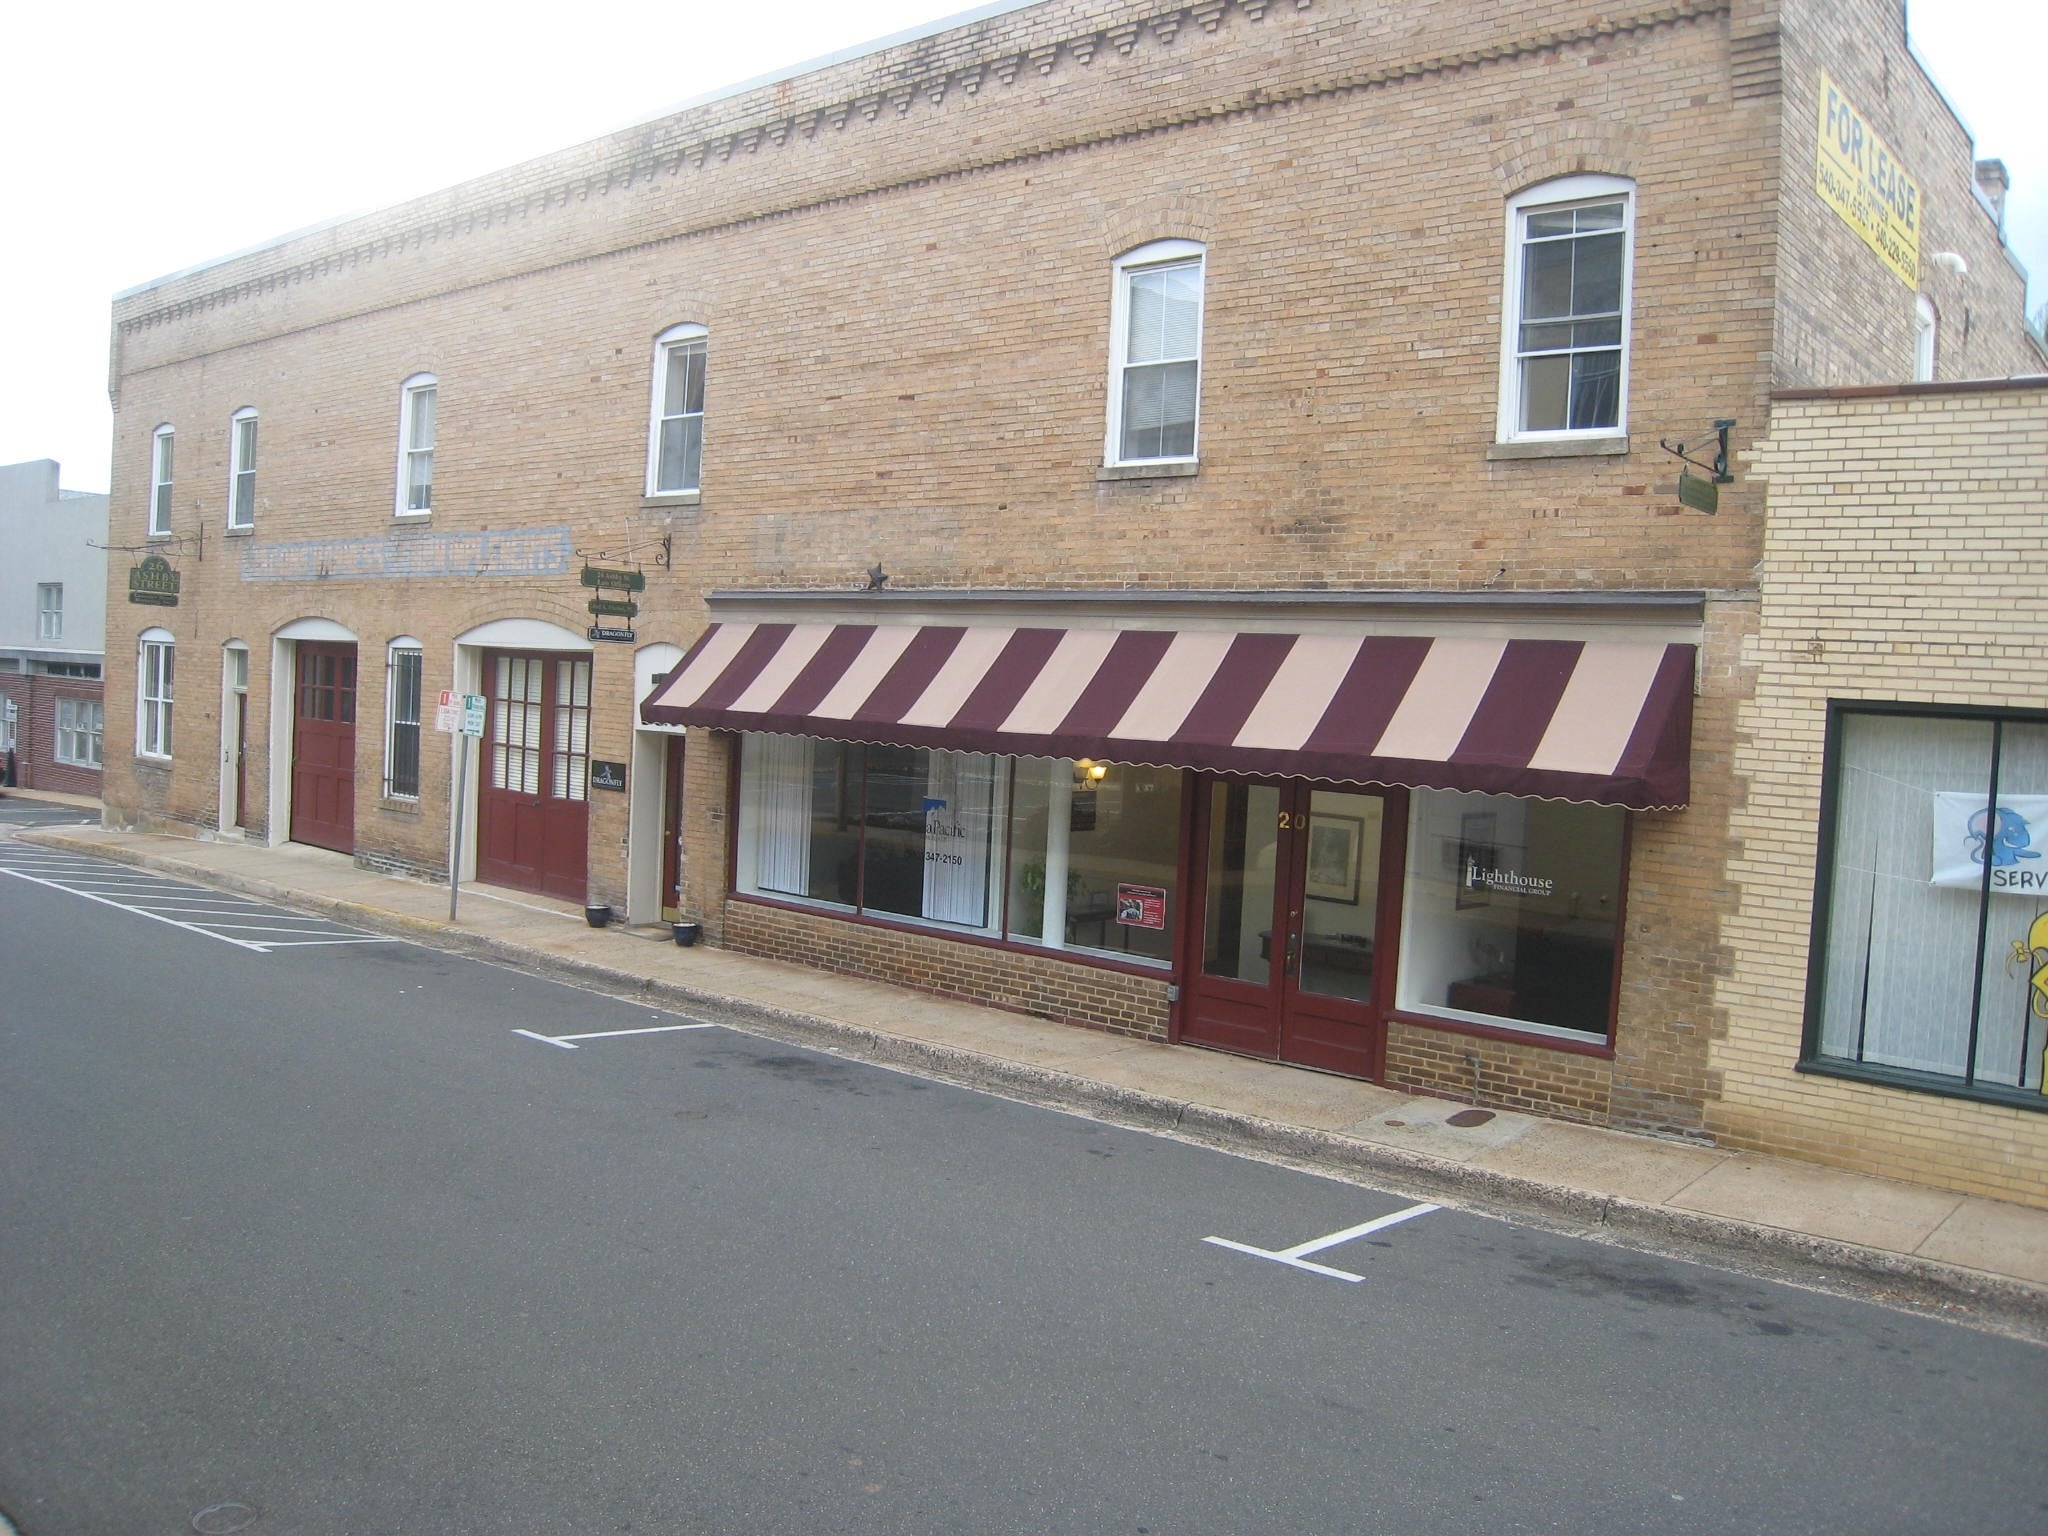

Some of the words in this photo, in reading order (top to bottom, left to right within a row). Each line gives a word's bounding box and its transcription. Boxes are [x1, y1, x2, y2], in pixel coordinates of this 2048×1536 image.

[1827, 86, 1863, 174] FOR
[1868, 136, 1916, 233] LEASE
[1857, 178, 1867, 200] BY
[1867, 189, 1888, 226] OWNER
[149, 561, 164, 571] 26
[136, 570, 177, 583] ASHBY
[134, 579, 176, 591] STREET
[602, 630, 633, 638] DRAGONFLY
[592, 776, 622, 787] DRAGONFLY
[1279, 811, 1306, 830] 20
[926, 852, 962, 865] 347-2150
[1472, 866, 1553, 889] Lighthouse
[1993, 870, 2048, 888] SERV
[1493, 884, 1527, 894] FINANCIAL
[1528, 888, 1552, 896] GROUP
